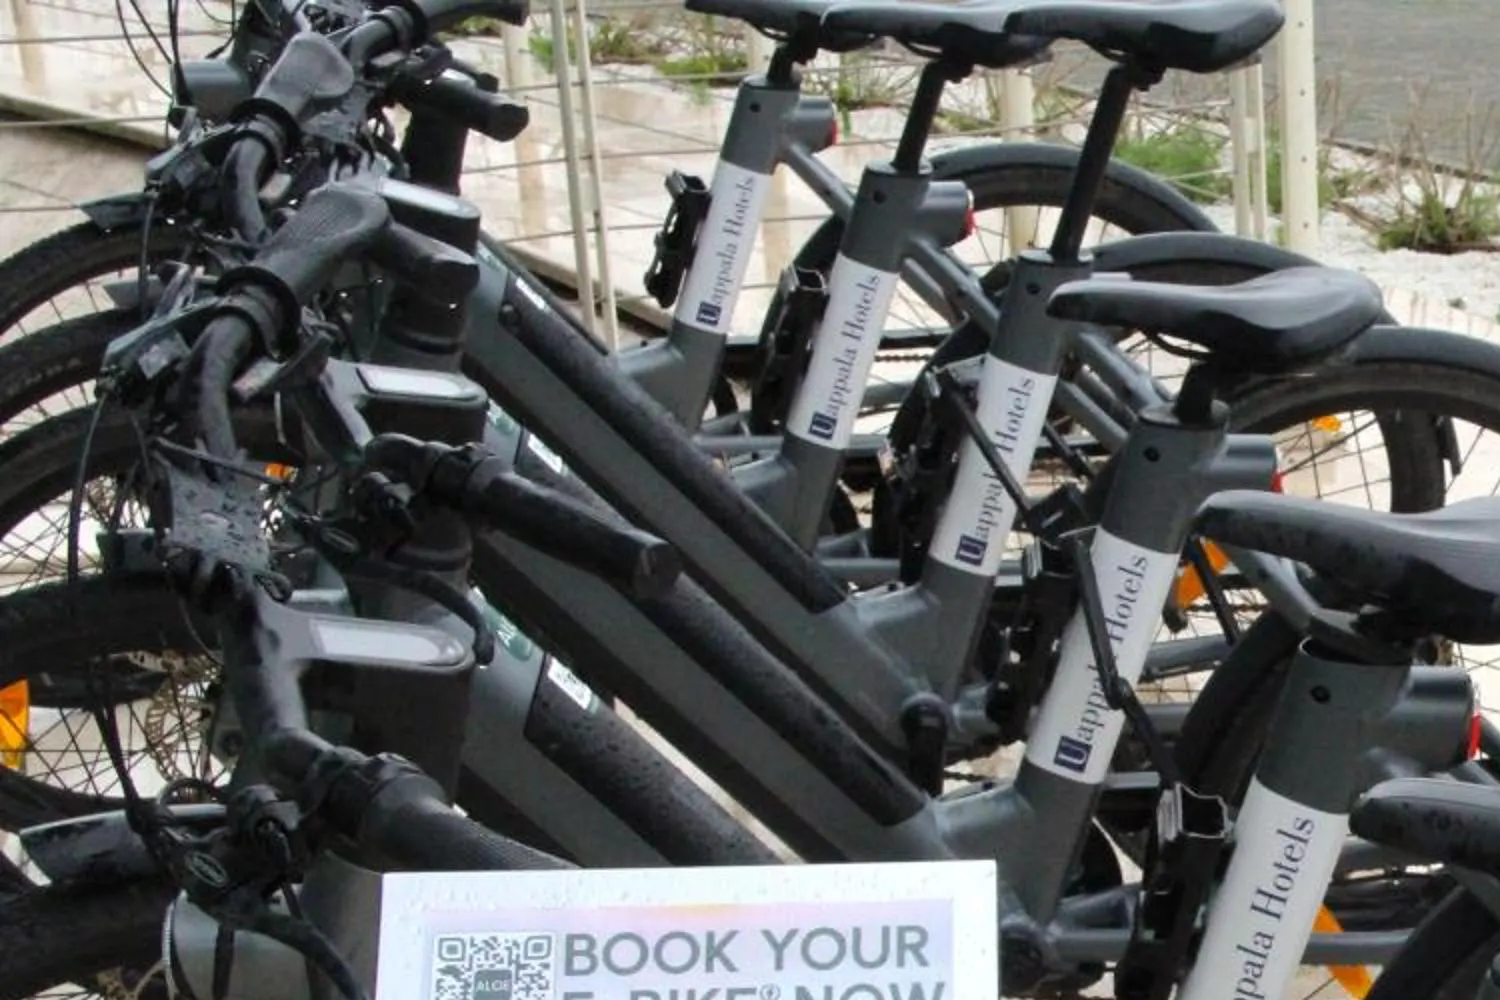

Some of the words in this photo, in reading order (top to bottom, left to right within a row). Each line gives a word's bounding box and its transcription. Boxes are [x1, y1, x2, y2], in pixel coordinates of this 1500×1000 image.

[723, 176, 755, 236] Hotels
[808, 348, 857, 440] Uappala
[841, 274, 881, 341] Hotels
[1250, 816, 1315, 920] Hotels
[564, 929, 740, 977] BOOK
[760, 924, 930, 972] YOUR
